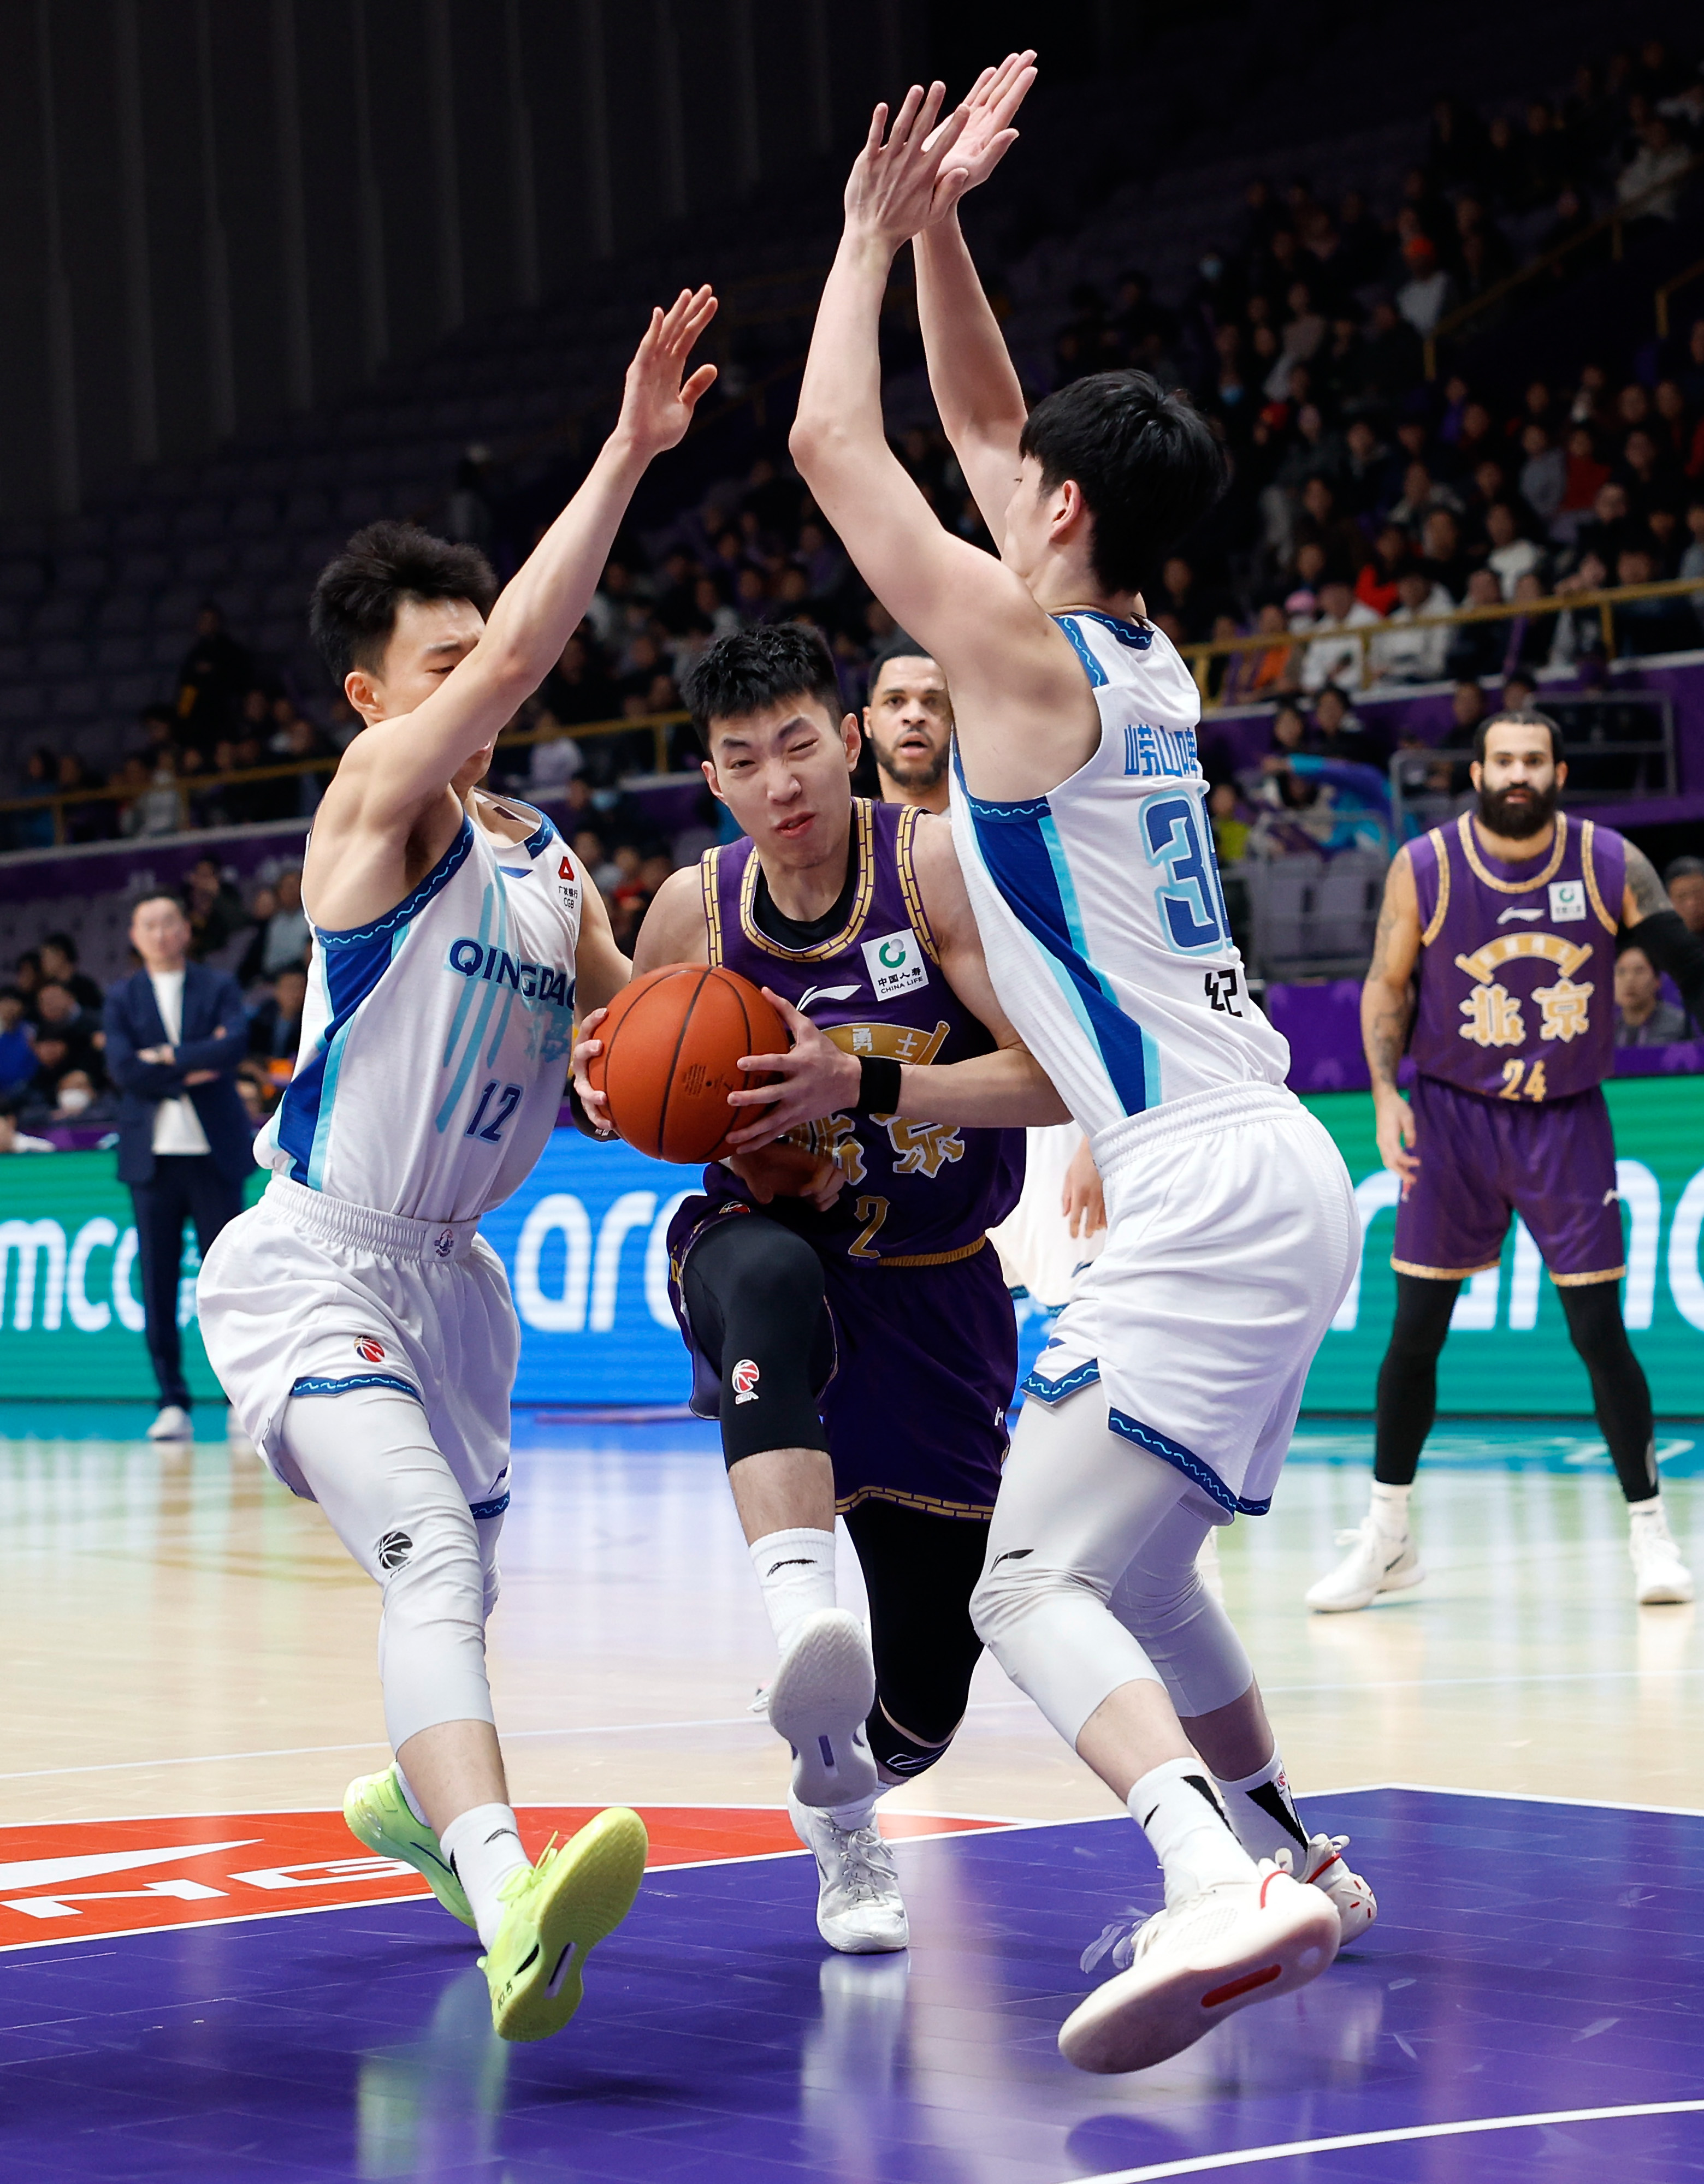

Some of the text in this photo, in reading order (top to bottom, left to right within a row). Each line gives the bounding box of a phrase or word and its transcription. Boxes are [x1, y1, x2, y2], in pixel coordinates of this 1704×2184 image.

[564, 897, 574, 909] CGB
[1139, 790, 1233, 956] 3
[880, 976, 923, 994] CHINA LIFE
[1458, 981, 1595, 1047] 北京
[465, 1079, 522, 1142] 12
[1499, 1058, 1547, 1102] 24
[848, 1195, 890, 1259] 2
